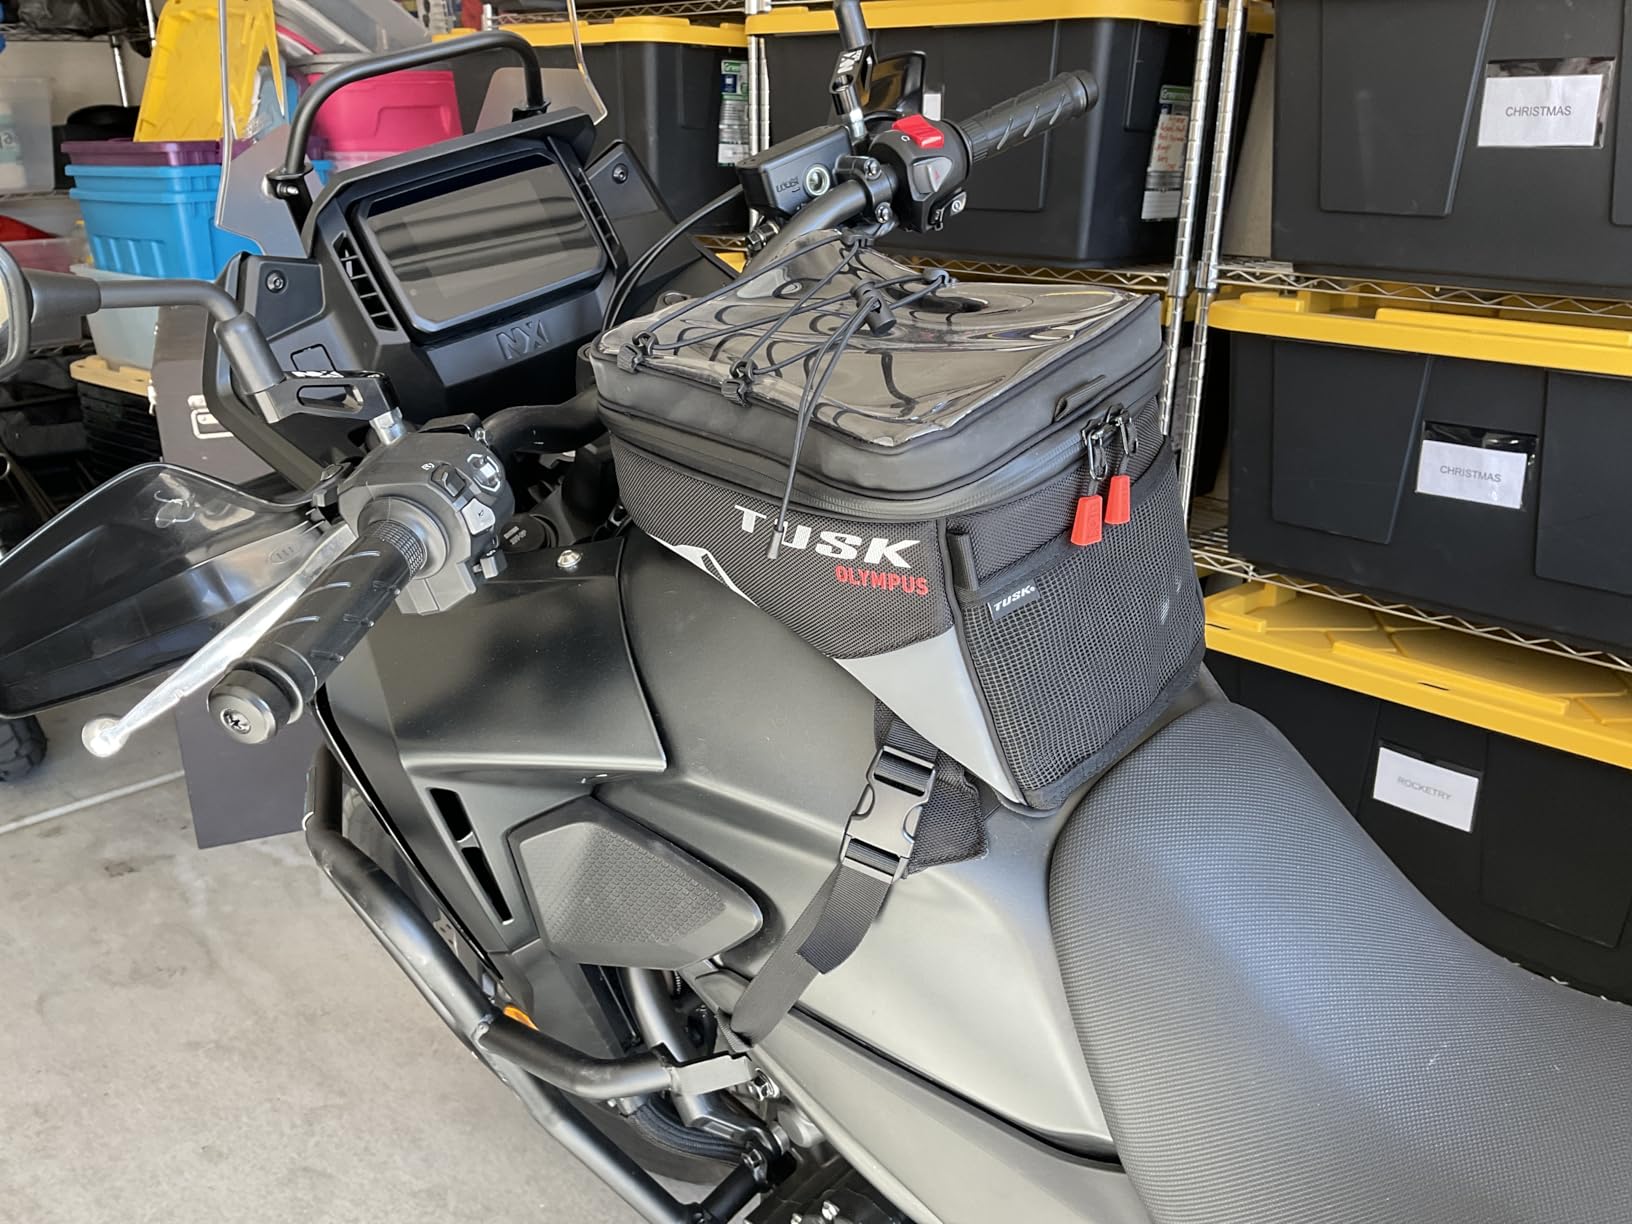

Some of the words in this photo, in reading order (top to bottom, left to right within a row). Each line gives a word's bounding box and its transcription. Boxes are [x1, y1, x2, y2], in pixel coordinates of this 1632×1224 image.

[1505, 105, 1572, 117] CHRISTMAS
[1440, 465, 1502, 483] CHRISTMAS
[735, 504, 921, 568] TUSK
[835, 565, 929, 596] OLYMPUS
[1397, 775, 1452, 800] ROCKETRY
